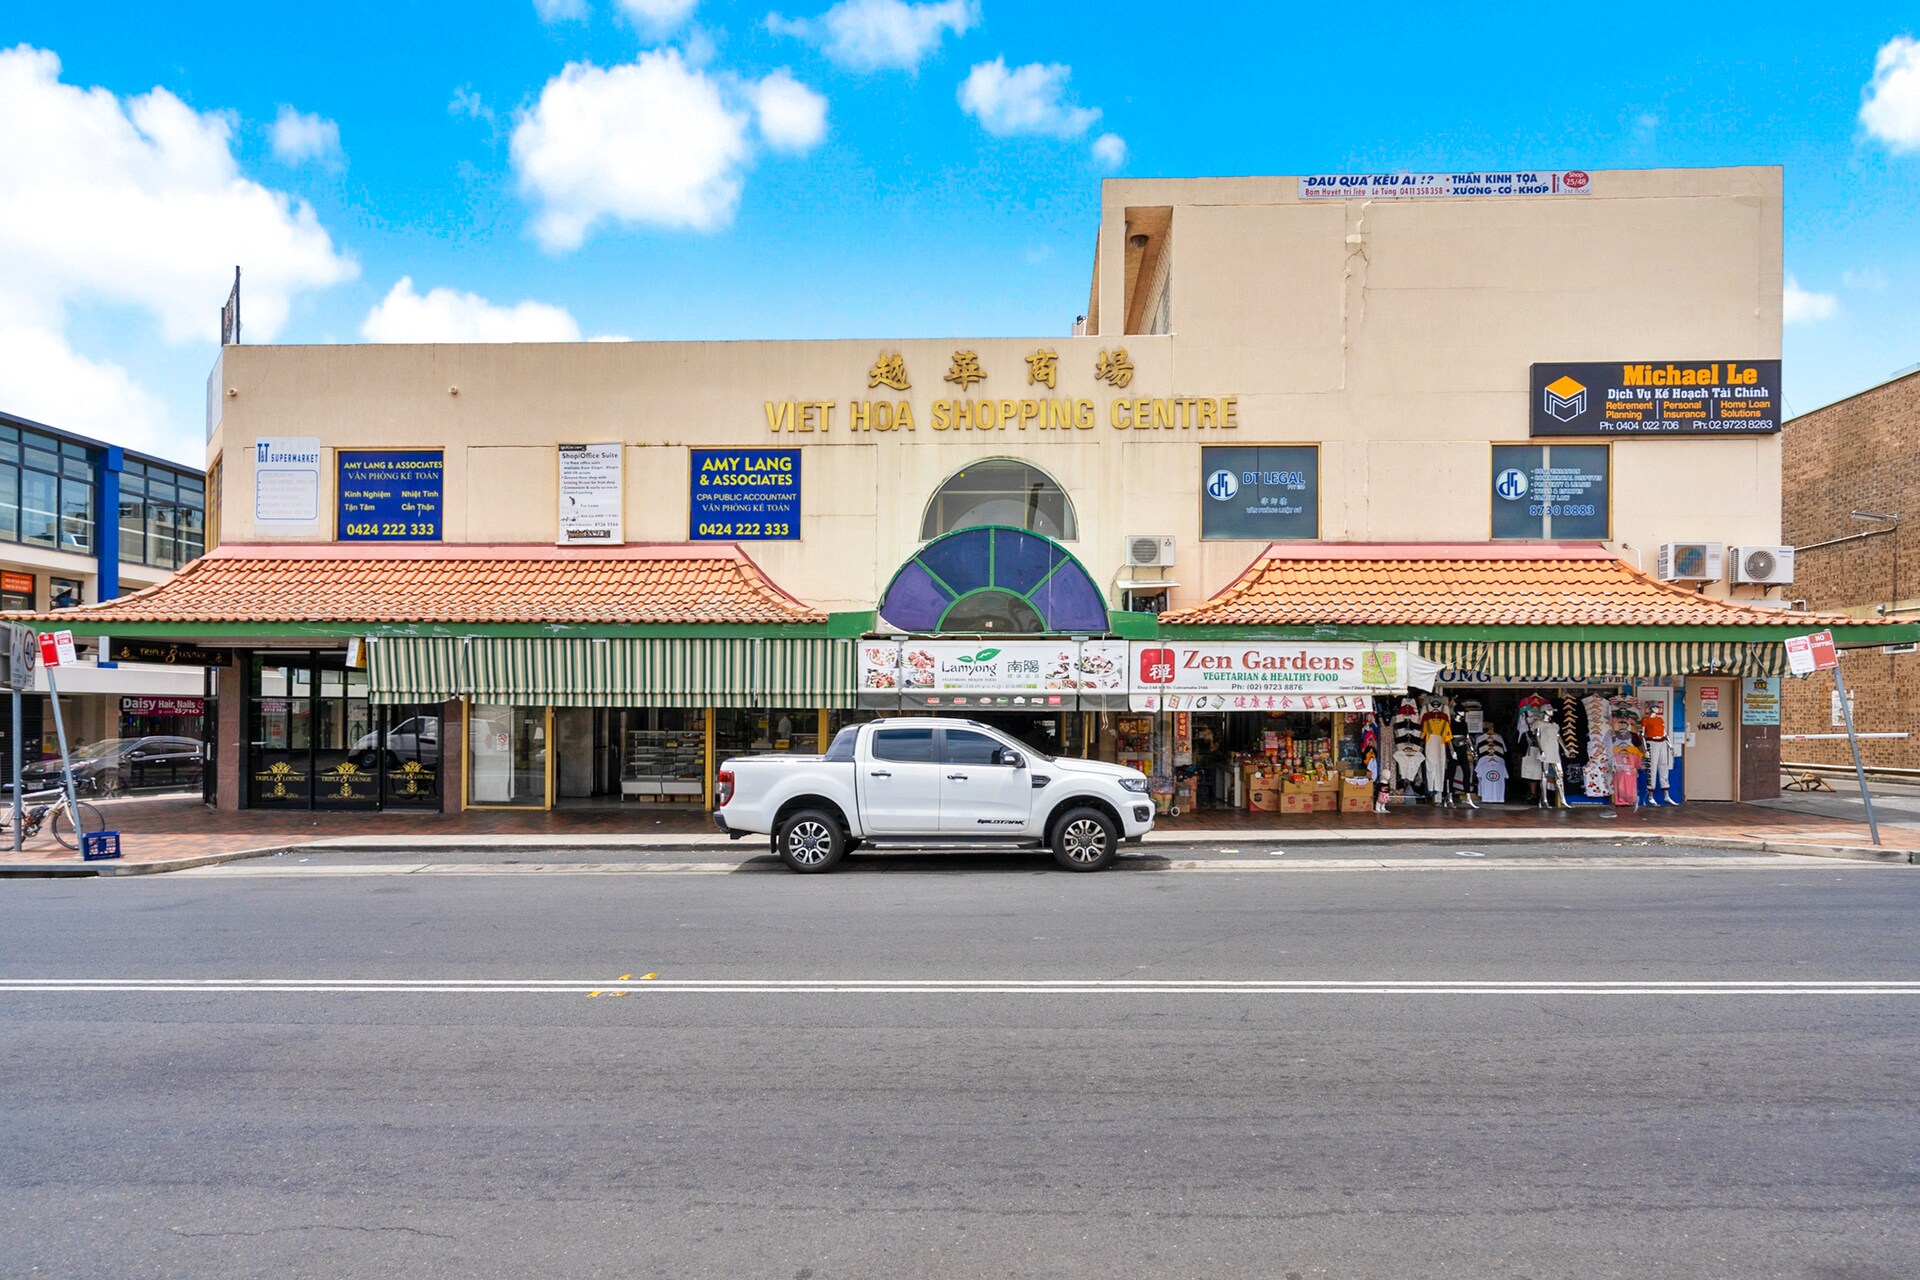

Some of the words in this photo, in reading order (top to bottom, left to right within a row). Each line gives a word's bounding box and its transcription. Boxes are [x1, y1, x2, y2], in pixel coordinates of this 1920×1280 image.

[1303, 176, 1336, 186] ĐAU
[1402, 176, 1416, 186] AI
[1486, 174, 1512, 183] KINH
[1516, 174, 1538, 184] TỌA
[868, 348, 1135, 392] 越華商場
[1623, 364, 1719, 386] Michael
[1726, 364, 1758, 385] Le
[1608, 388, 1633, 400] Dịch
[1636, 389, 1651, 400] Vụ
[1655, 387, 1669, 399] Kế
[1672, 388, 1708, 400] Hoạch
[1712, 388, 1731, 398] Tài
[1735, 387, 1769, 398] Chính
[1606, 401, 1653, 410] Retirement
[1664, 401, 1702, 409] Personal
[1721, 400, 1746, 408] Home
[1748, 400, 1770, 408] Loan
[765, 401, 835, 432] VIET
[851, 400, 916, 432] HOA
[930, 398, 1095, 432] SHOPPING
[1110, 397, 1239, 430] CENTRE
[1606, 411, 1642, 420] Planning
[1664, 410, 1706, 419] Insurance
[1721, 409, 1761, 418] Solutions
[1600, 422, 1614, 430] Ph:
[1616, 421, 1639, 430] 0404
[1642, 421, 1659, 430] 022
[1662, 421, 1679, 430] 706
[1693, 420, 1707, 430] Ph:
[1709, 420, 1722, 430] 02
[1723, 420, 1747, 430] 9723
[1748, 420, 1773, 429] 8263
[271, 454, 318, 463] SUPERMARKET
[702, 458, 741, 472] AMY
[745, 457, 792, 472] LANG
[699, 474, 709, 486] &
[712, 474, 793, 486] ASSOCIATES
[1243, 472, 1261, 484] DT
[1264, 471, 1306, 484] LEGAL
[363, 490, 391, 499] Nghiệm
[1530, 504, 1561, 516] 8730
[1563, 504, 1595, 516] 8883
[347, 523, 379, 535] 0424
[382, 523, 406, 535] 222
[410, 523, 434, 535] 333
[699, 523, 732, 535] 0424
[736, 523, 760, 535] 222
[764, 523, 789, 535] 333
[1183, 650, 1233, 669] Zen
[1242, 650, 1355, 670] Gardens
[942, 661, 997, 677] Lamyong
[1007, 660, 1040, 673] 南陽
[1203, 672, 1259, 681] VEGETARIAN
[1261, 672, 1267, 681] &
[1270, 672, 1311, 681] HEALTHY
[1313, 672, 1338, 681] FOOD
[123, 698, 156, 710] Daisy
[158, 700, 175, 709] Hair,
[177, 700, 195, 708] Nails
[274, 774, 282, 782] 8
[340, 774, 349, 783] 8
